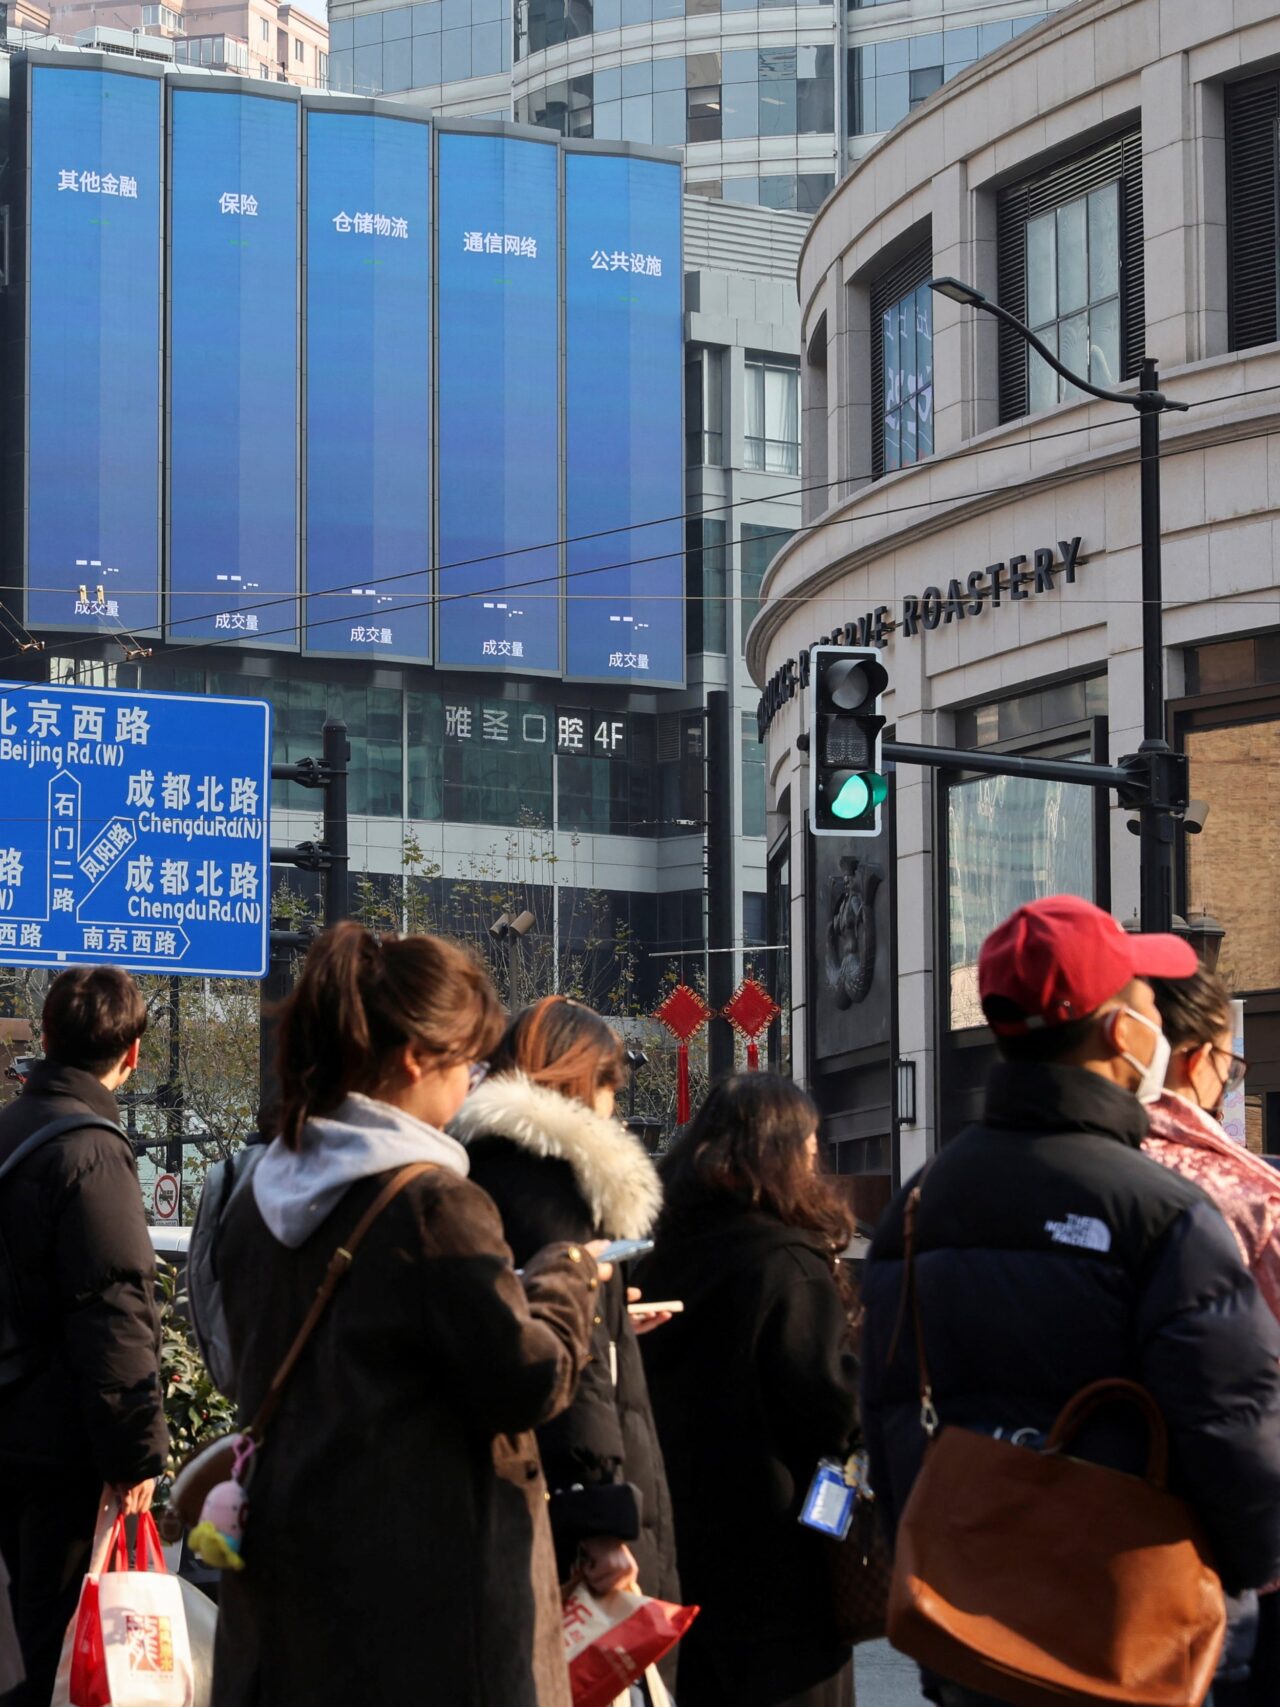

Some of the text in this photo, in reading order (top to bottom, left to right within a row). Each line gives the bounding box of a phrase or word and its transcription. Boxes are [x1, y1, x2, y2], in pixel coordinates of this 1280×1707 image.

[58, 169, 138, 199] 其他金融
[219, 192, 259, 217] 保险
[332, 211, 409, 239] 仓储物流
[463, 231, 537, 259] 通信网络
[590, 250, 662, 277] 公共设施
[902, 536, 1083, 638] ROASTERY
[74, 599, 120, 617] 成交量
[215, 613, 259, 631] 成交量
[350, 626, 393, 645] 成交量
[482, 639, 524, 658] 成交量
[609, 652, 650, 670] 成交量
[445, 705, 624, 750] 雅圣口腔 4F
[0, 738, 124, 770] Beijing Rd.(W)
[126, 768, 260, 816] 成都北路
[52, 793, 76, 913] 石门二路
[79, 822, 133, 884] 凤阳路
[125, 854, 260, 900] 成都北路
[83, 926, 177, 955] 南京西路
